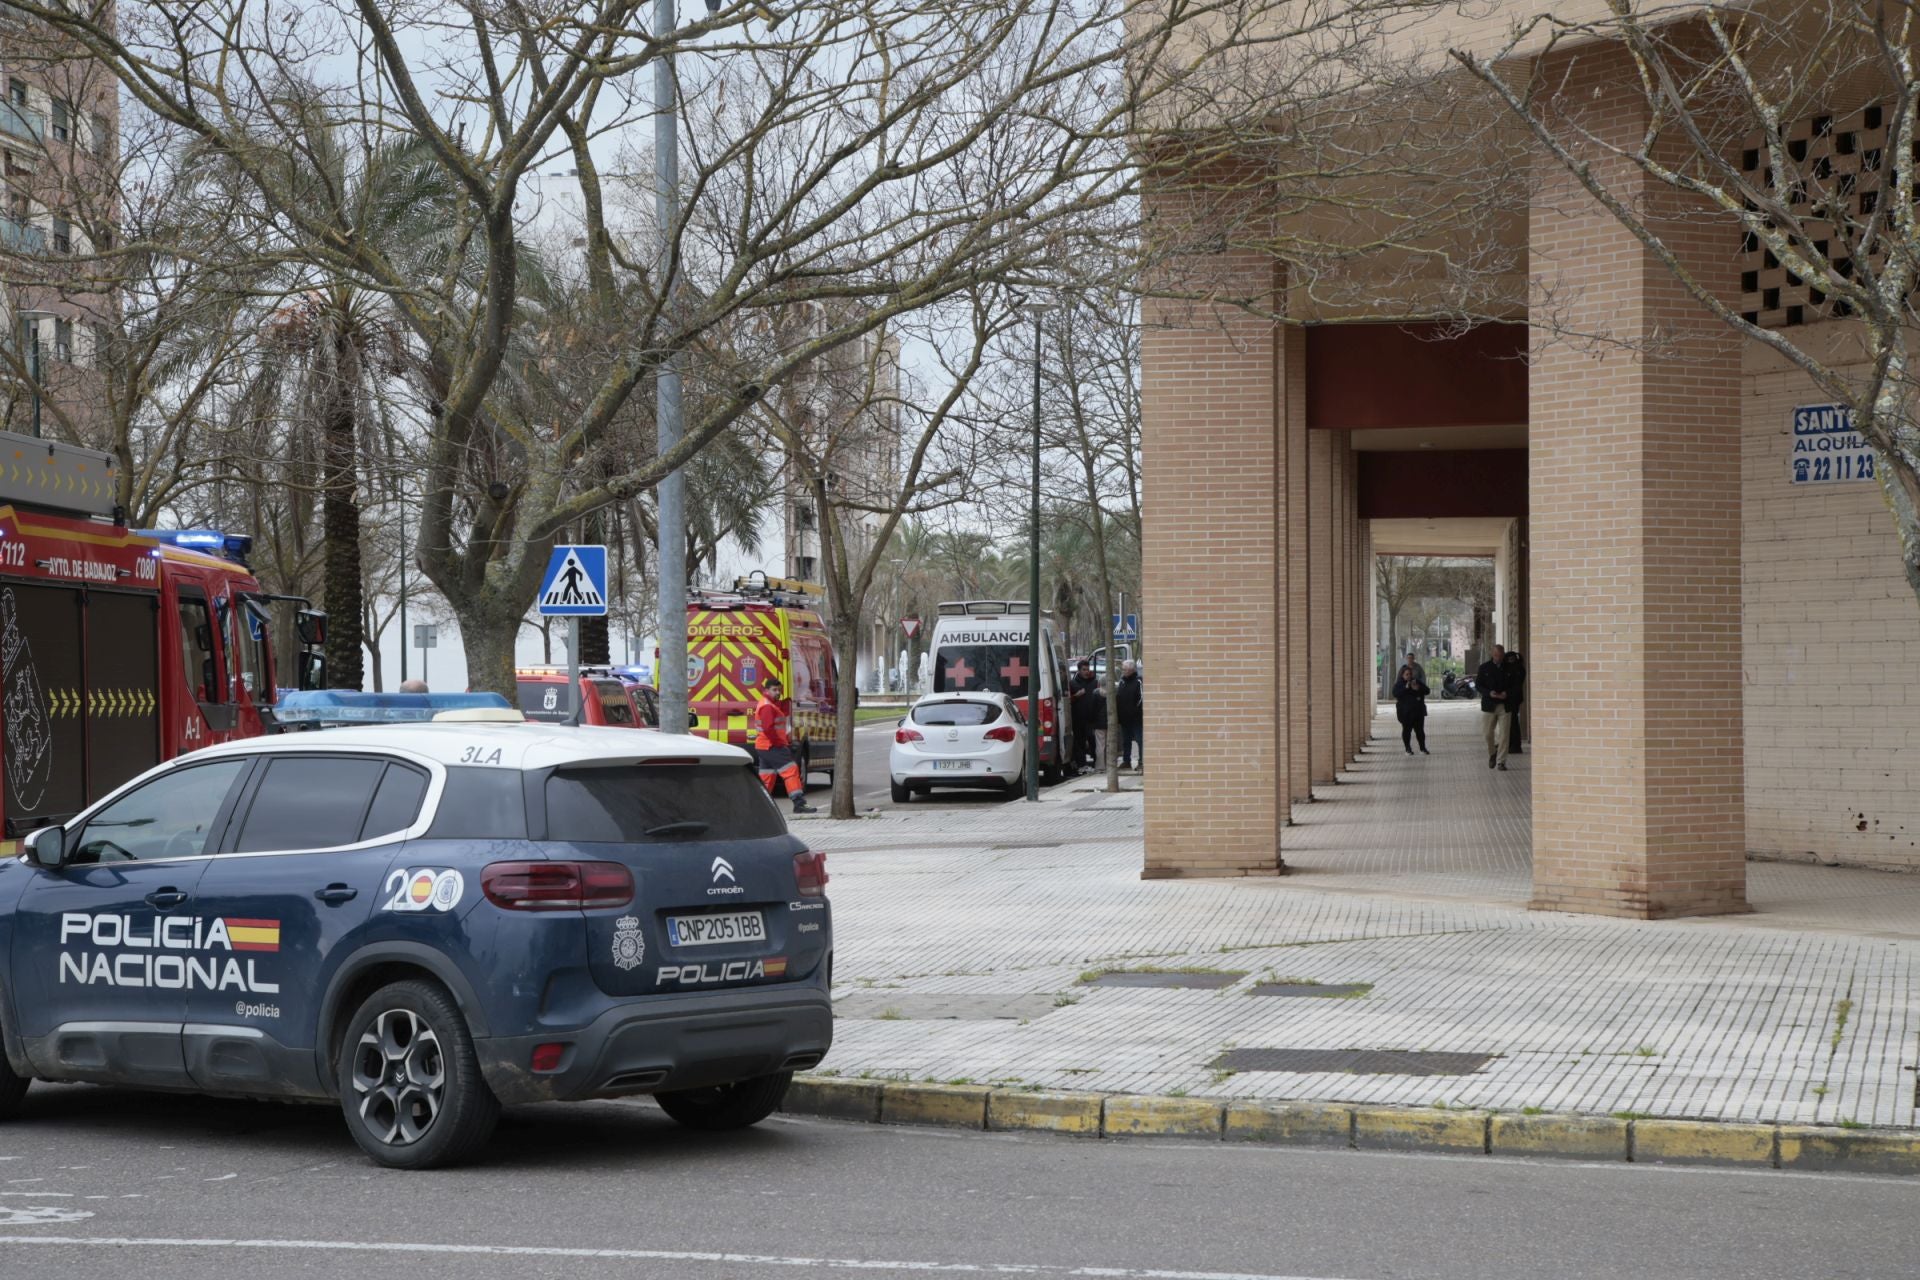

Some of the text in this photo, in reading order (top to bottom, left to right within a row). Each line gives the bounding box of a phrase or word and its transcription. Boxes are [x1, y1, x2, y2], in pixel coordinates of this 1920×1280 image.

[1813, 454, 1874, 480] 22 11 23
[5, 541, 25, 567] 112
[49, 556, 117, 581] AYTO. DE BADAJOZ
[140, 558, 156, 580] 080
[687, 625, 764, 636] OMBEROS
[460, 745, 502, 765] 3LA
[59, 951, 280, 993] NACIONAL
[235, 1000, 280, 1019] @policia
